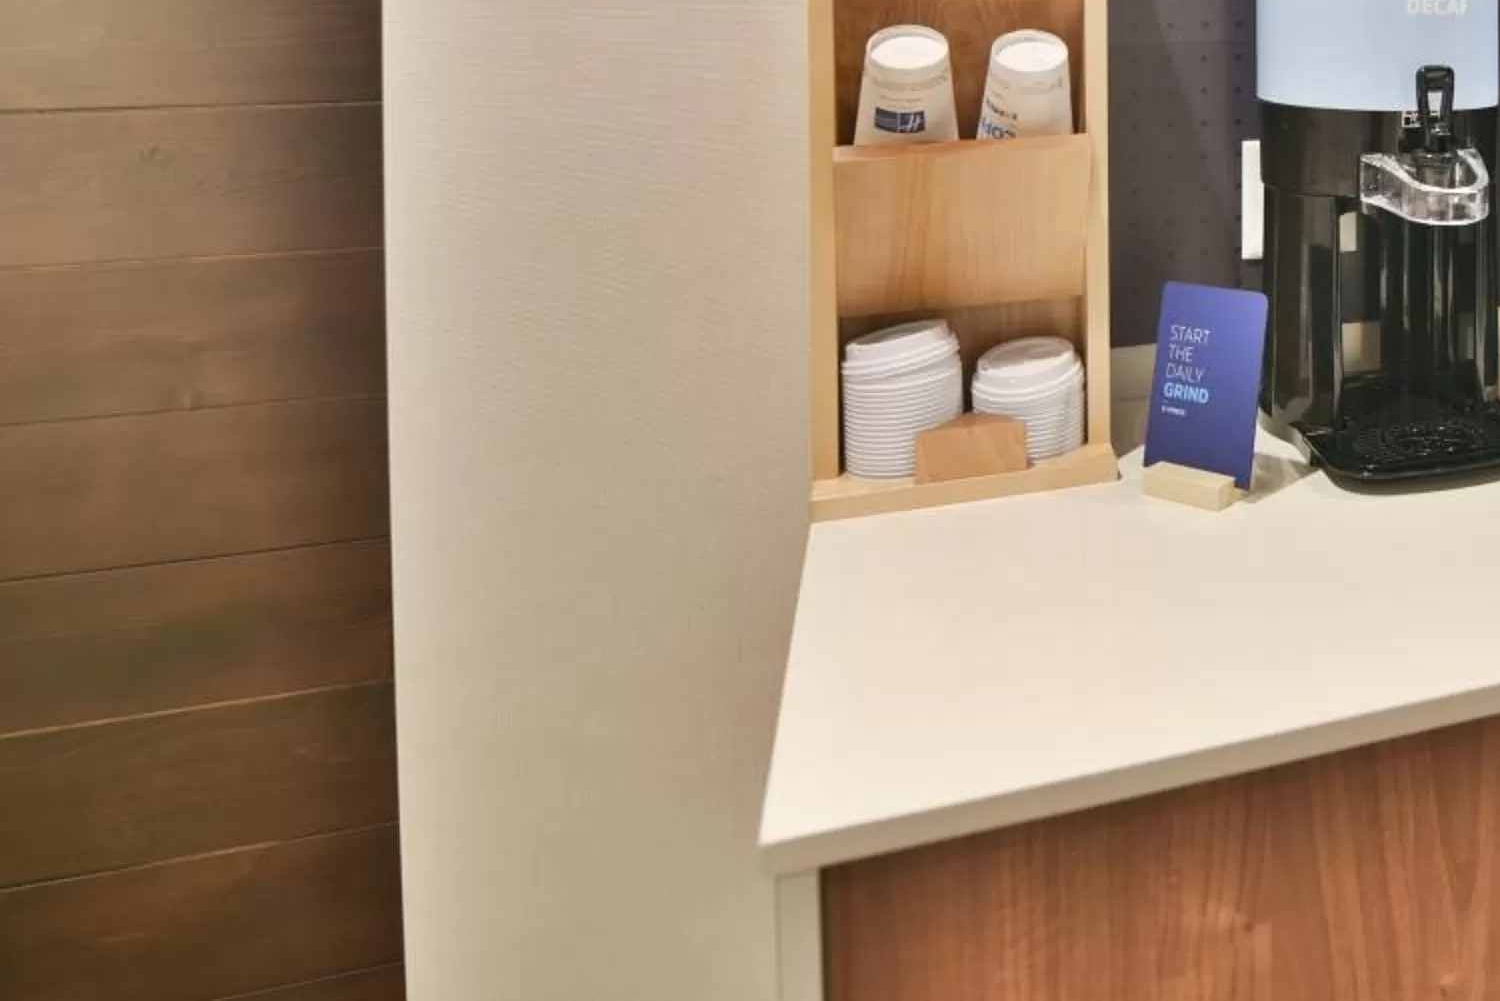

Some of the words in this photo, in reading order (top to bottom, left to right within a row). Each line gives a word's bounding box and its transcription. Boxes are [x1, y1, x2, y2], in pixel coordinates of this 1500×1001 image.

[1170, 324, 1213, 344] START
[1167, 343, 1195, 363] THE
[1165, 363, 1204, 383] DAILY
[1163, 382, 1209, 404] GRIND
